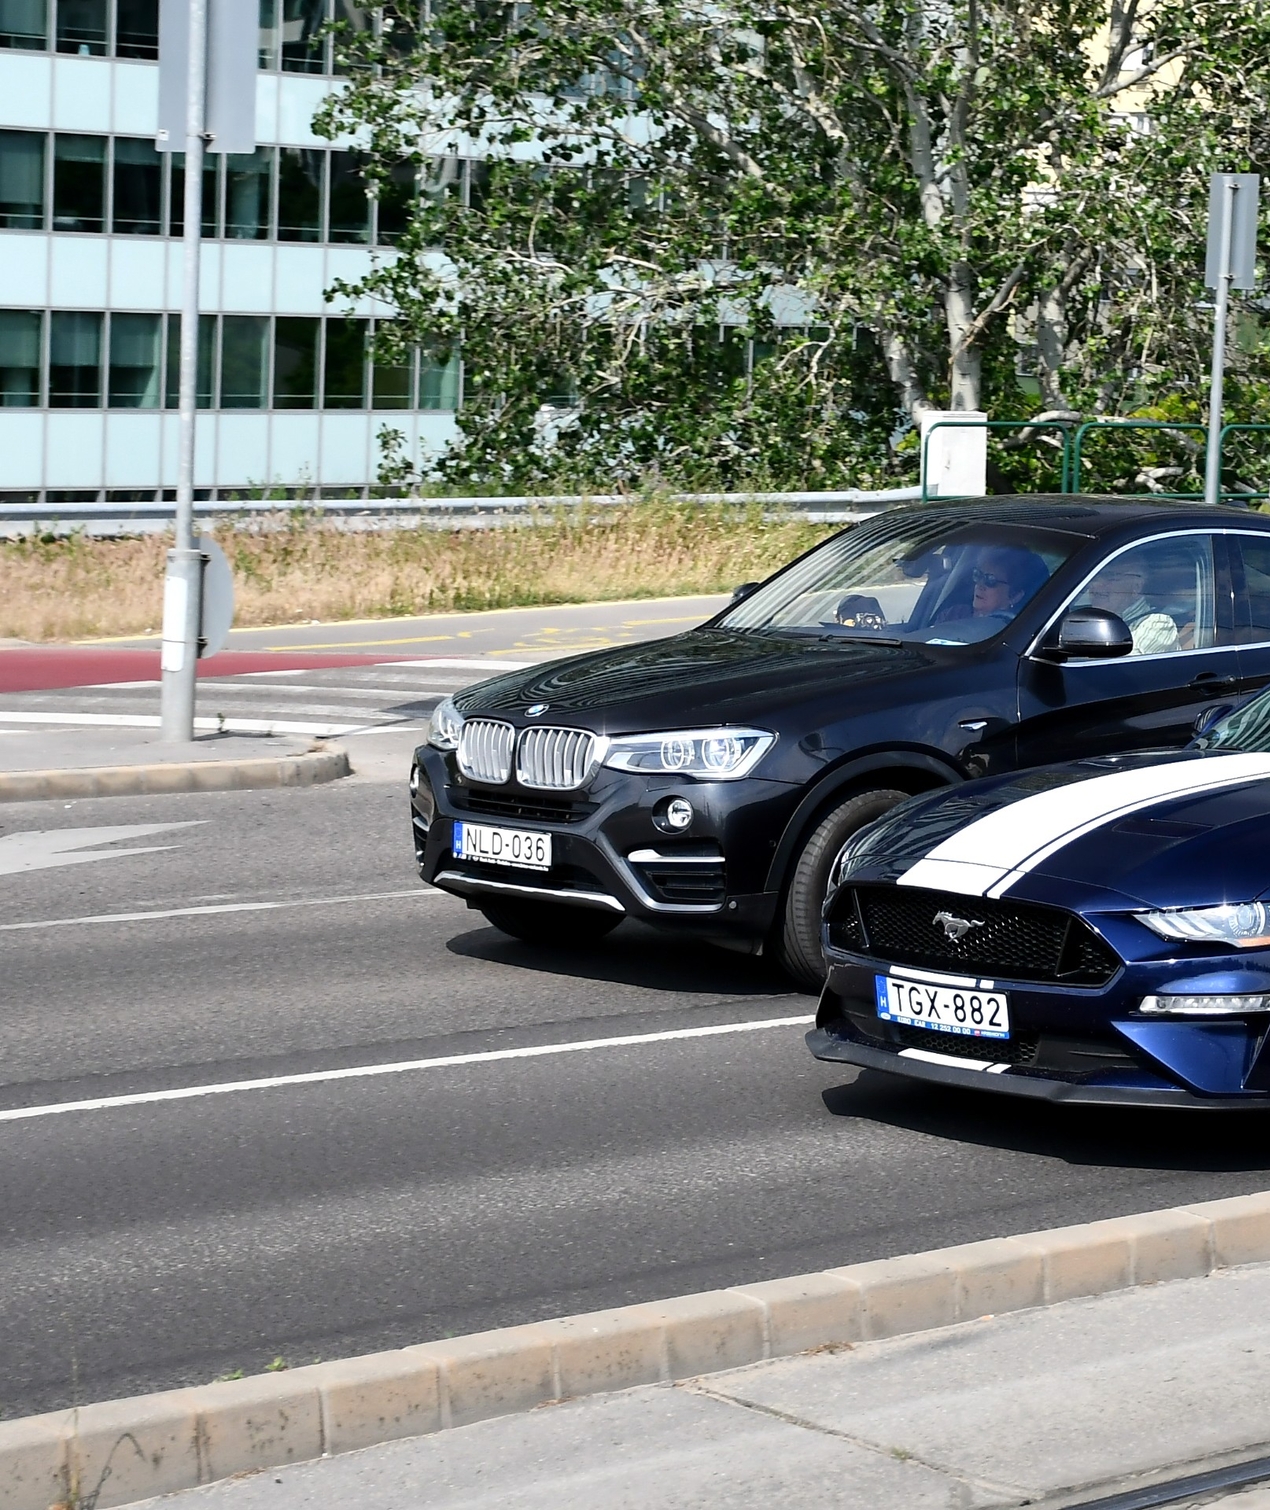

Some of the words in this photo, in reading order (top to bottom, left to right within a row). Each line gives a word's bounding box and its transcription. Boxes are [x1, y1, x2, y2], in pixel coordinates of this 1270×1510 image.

[455, 840, 461, 850] H
[466, 828, 545, 862] NLD-036
[880, 996, 887, 1008] H
[891, 982, 1002, 1027] TGX-882
[939, 1024, 951, 1033] 252
